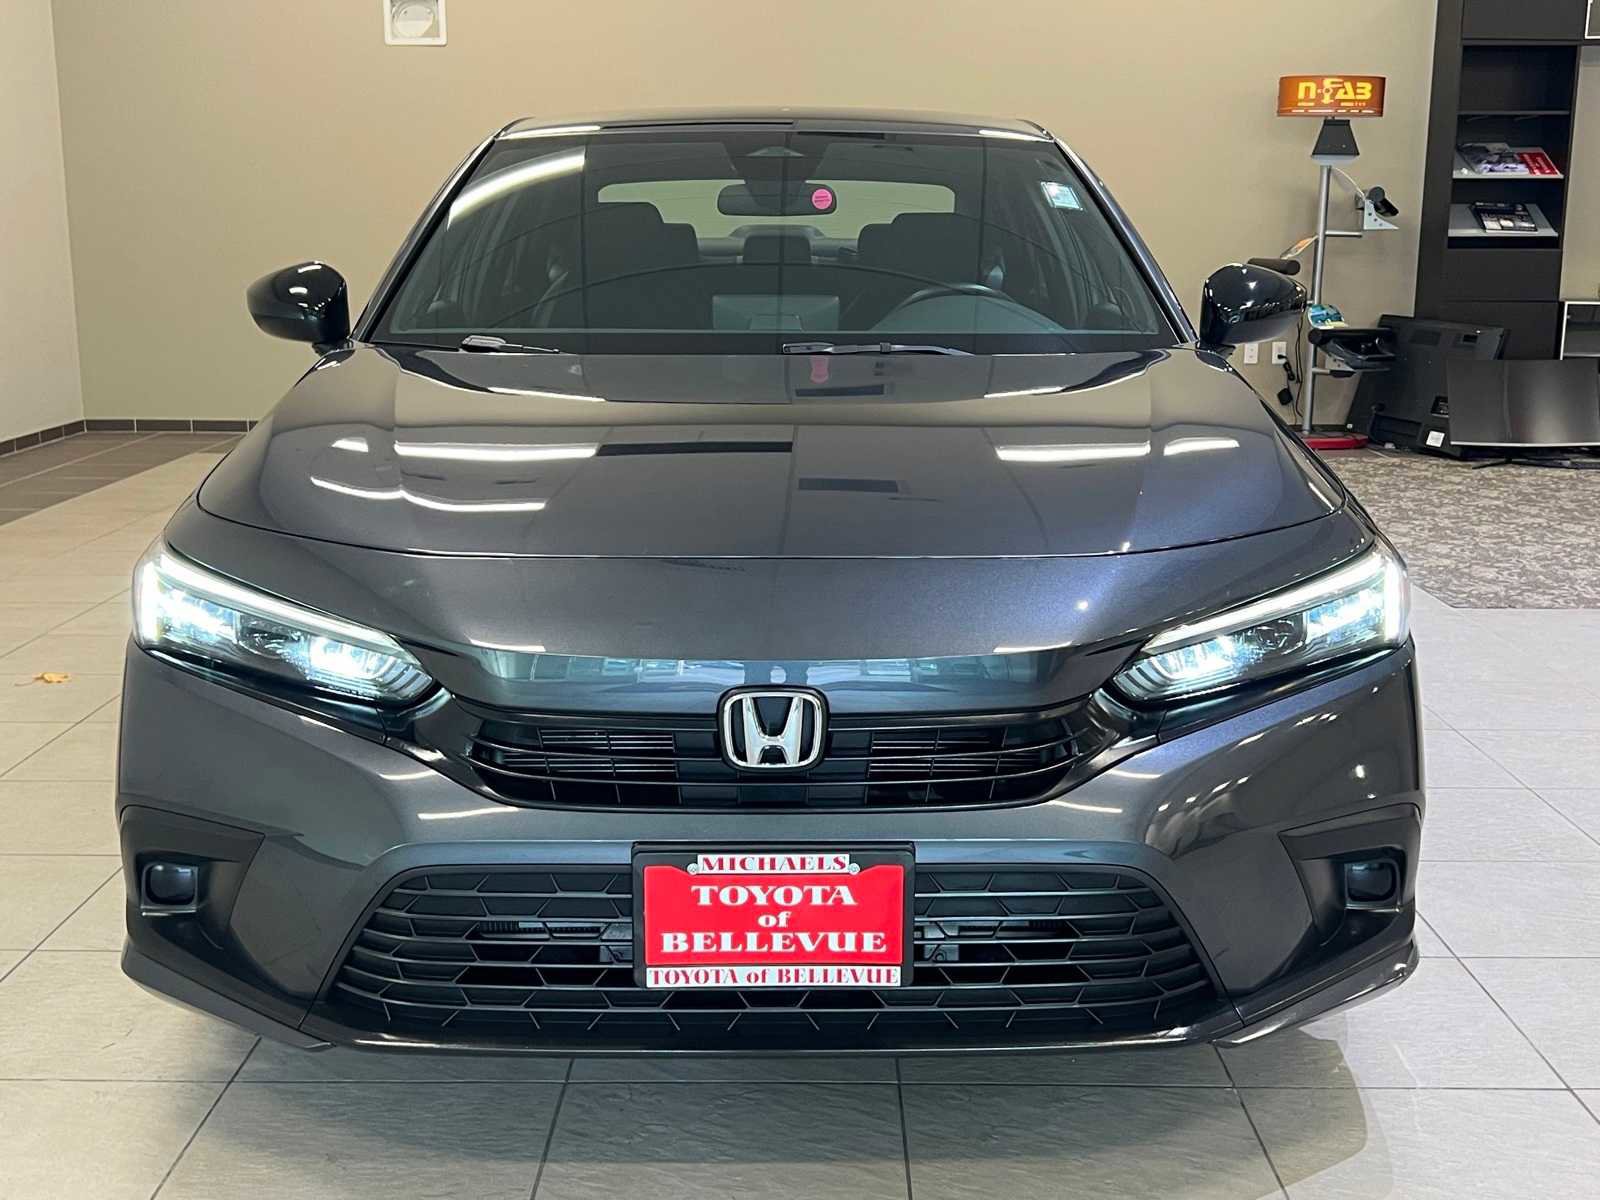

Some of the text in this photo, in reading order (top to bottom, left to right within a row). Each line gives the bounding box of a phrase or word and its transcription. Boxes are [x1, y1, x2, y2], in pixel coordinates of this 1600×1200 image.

[702, 856, 847, 871] MICHAELS
[691, 885, 858, 906] TOYOTA
[758, 911, 791, 928] of
[661, 932, 887, 953] BELLEVUE
[649, 968, 899, 985] TOYOTA of BELLEVUE
